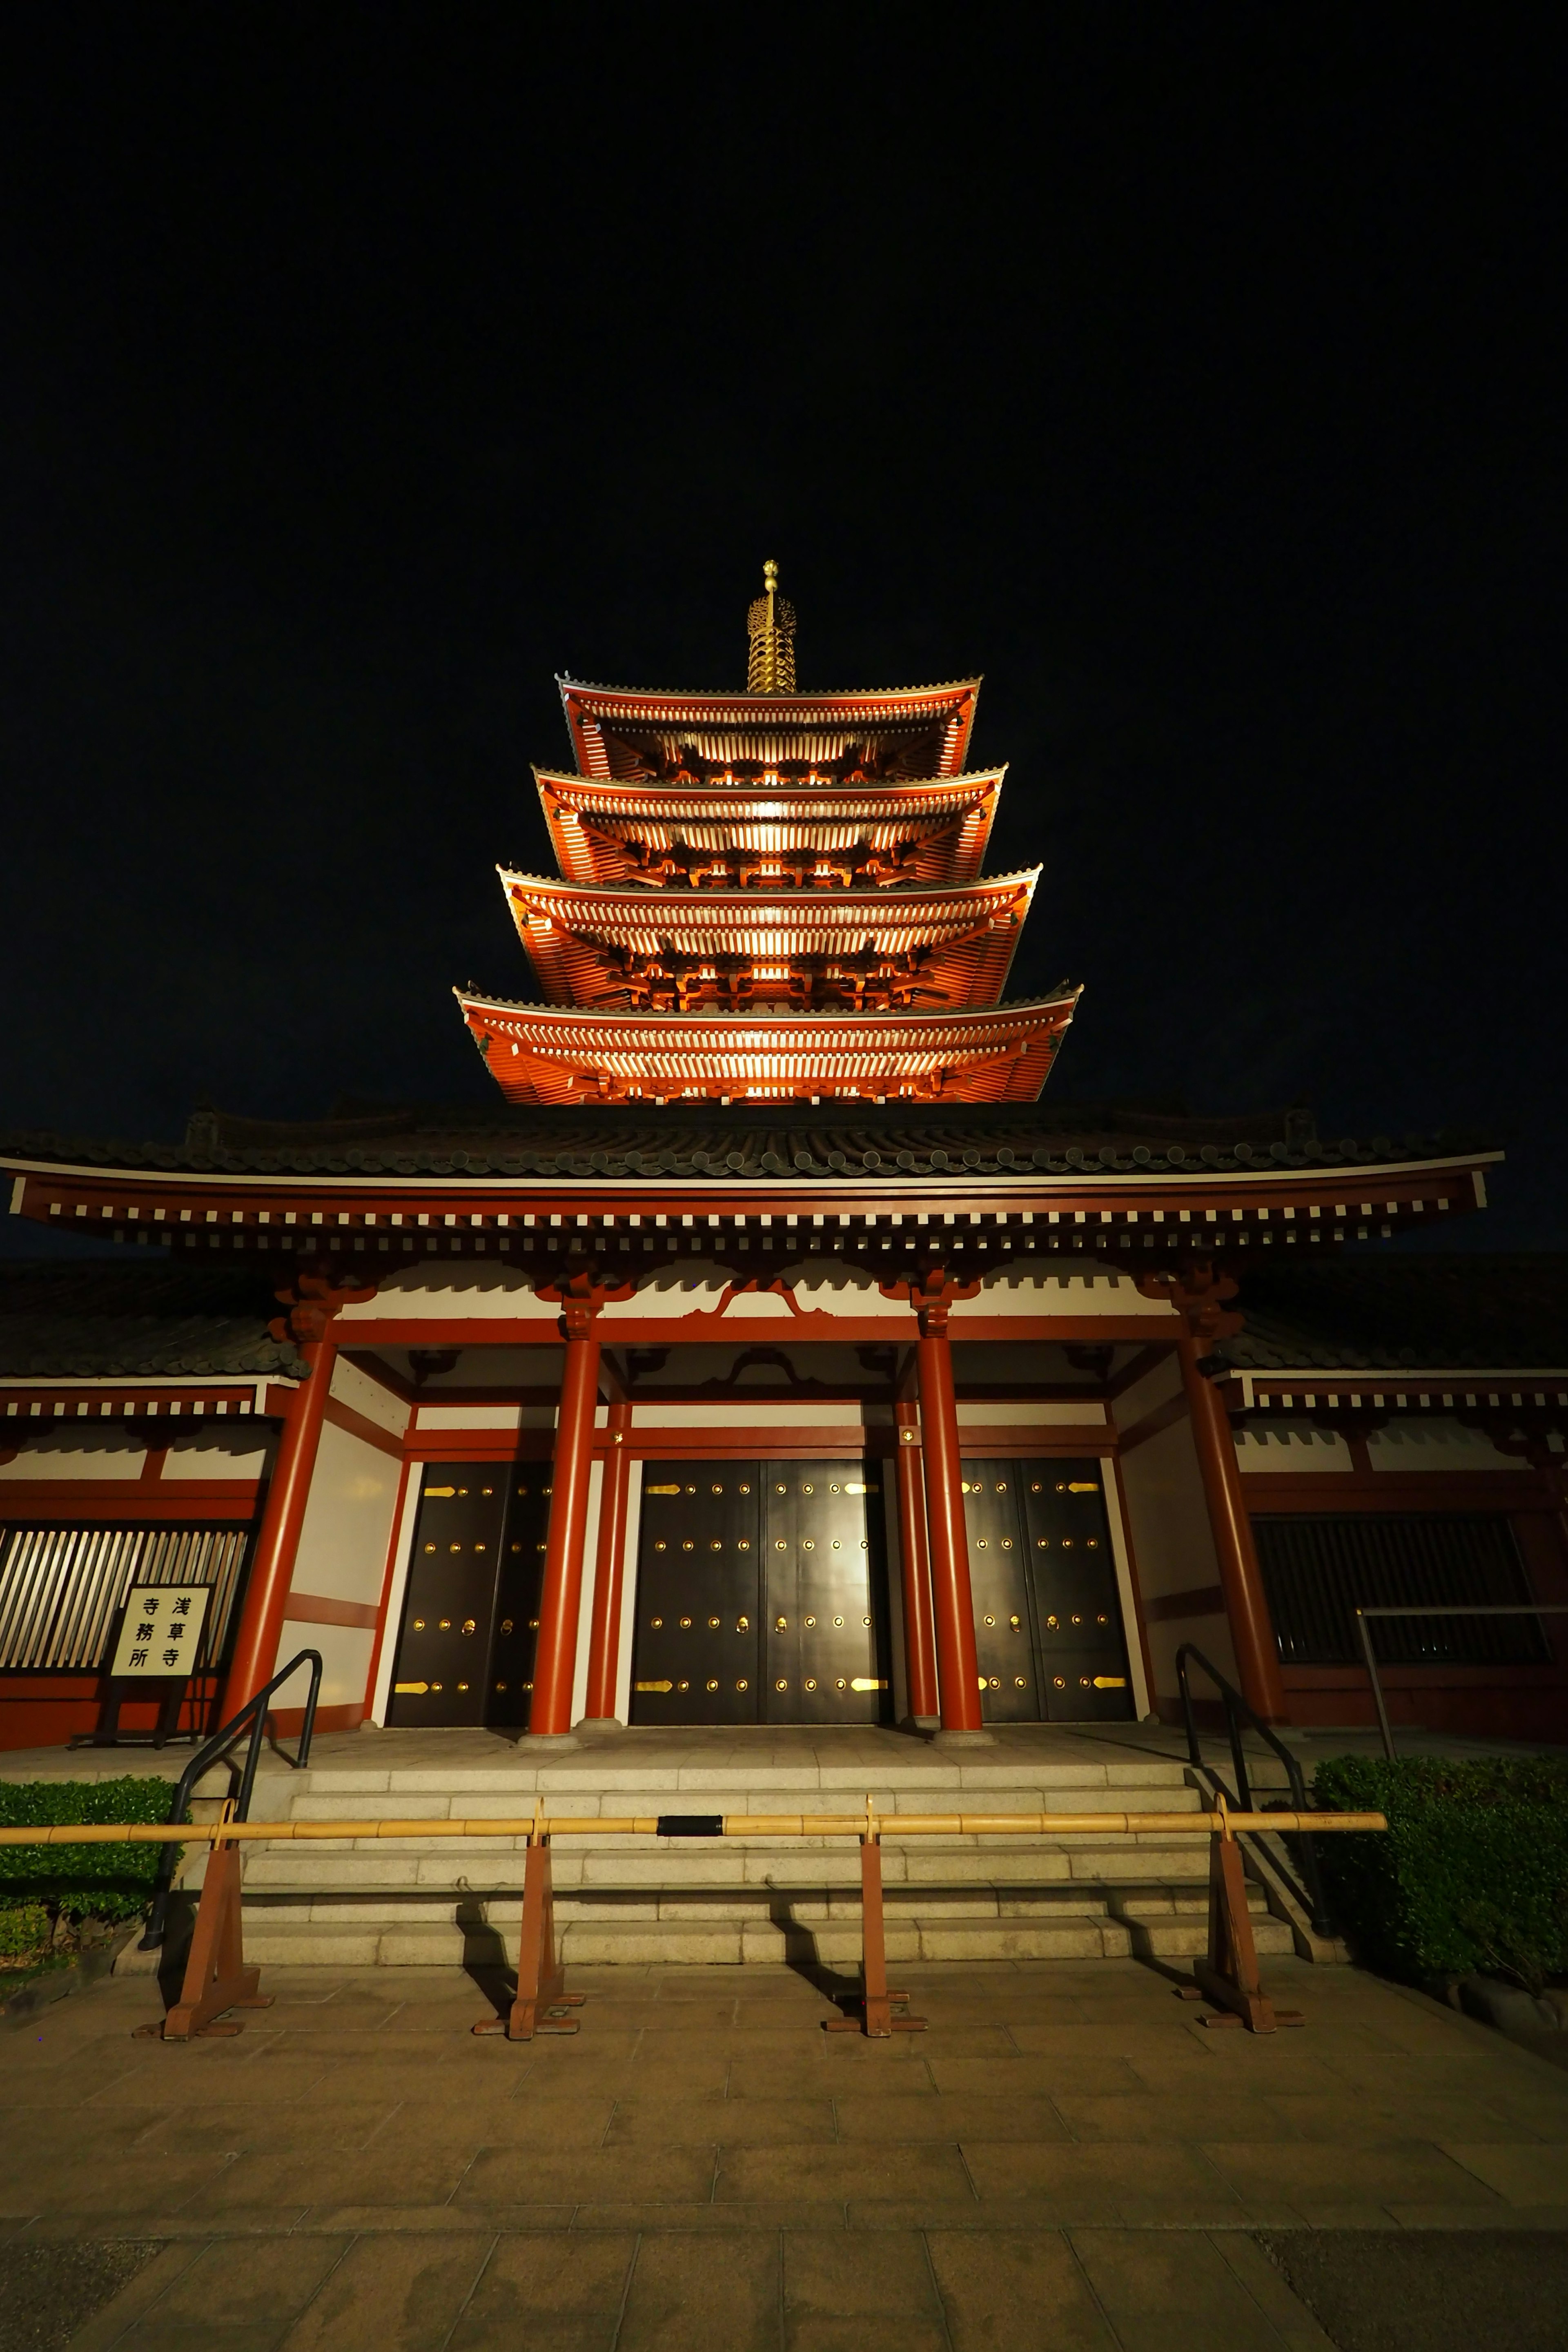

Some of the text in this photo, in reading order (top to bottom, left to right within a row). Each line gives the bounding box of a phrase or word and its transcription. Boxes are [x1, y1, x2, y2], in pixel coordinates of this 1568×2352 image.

[129, 1598, 159, 1667] 寺務所
[163, 1597, 191, 1666] 浅草寺
